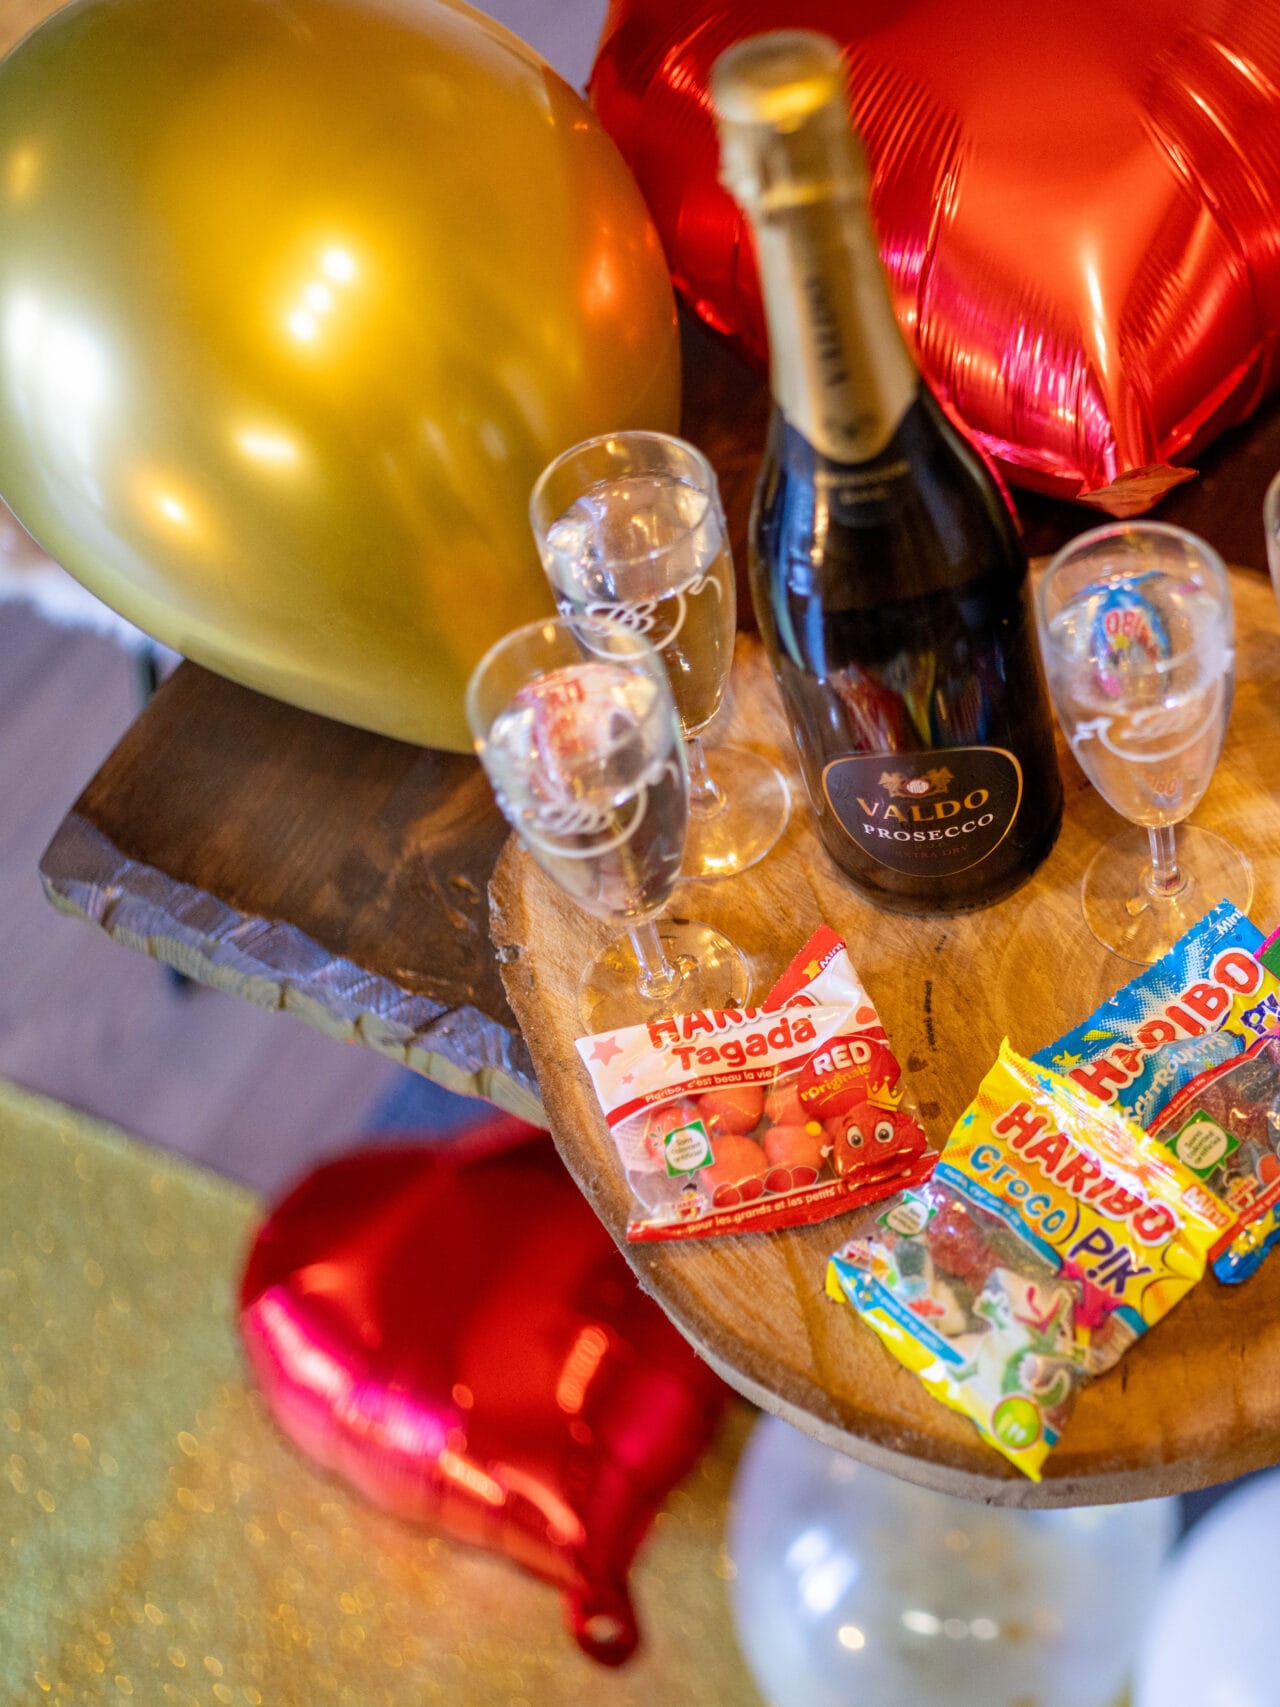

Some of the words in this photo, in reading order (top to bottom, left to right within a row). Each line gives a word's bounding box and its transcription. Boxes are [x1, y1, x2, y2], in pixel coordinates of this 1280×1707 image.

[856, 788, 990, 822] VALDO
[862, 813, 994, 842] PROSECCO
[672, 1017, 817, 1071] Tagada
[812, 1040, 871, 1076] RED
[687, 1078, 713, 1090] c'est
[713, 1073, 742, 1085] beau
[743, 1069, 755, 1080] la
[993, 1100, 1178, 1244] HARIBO
